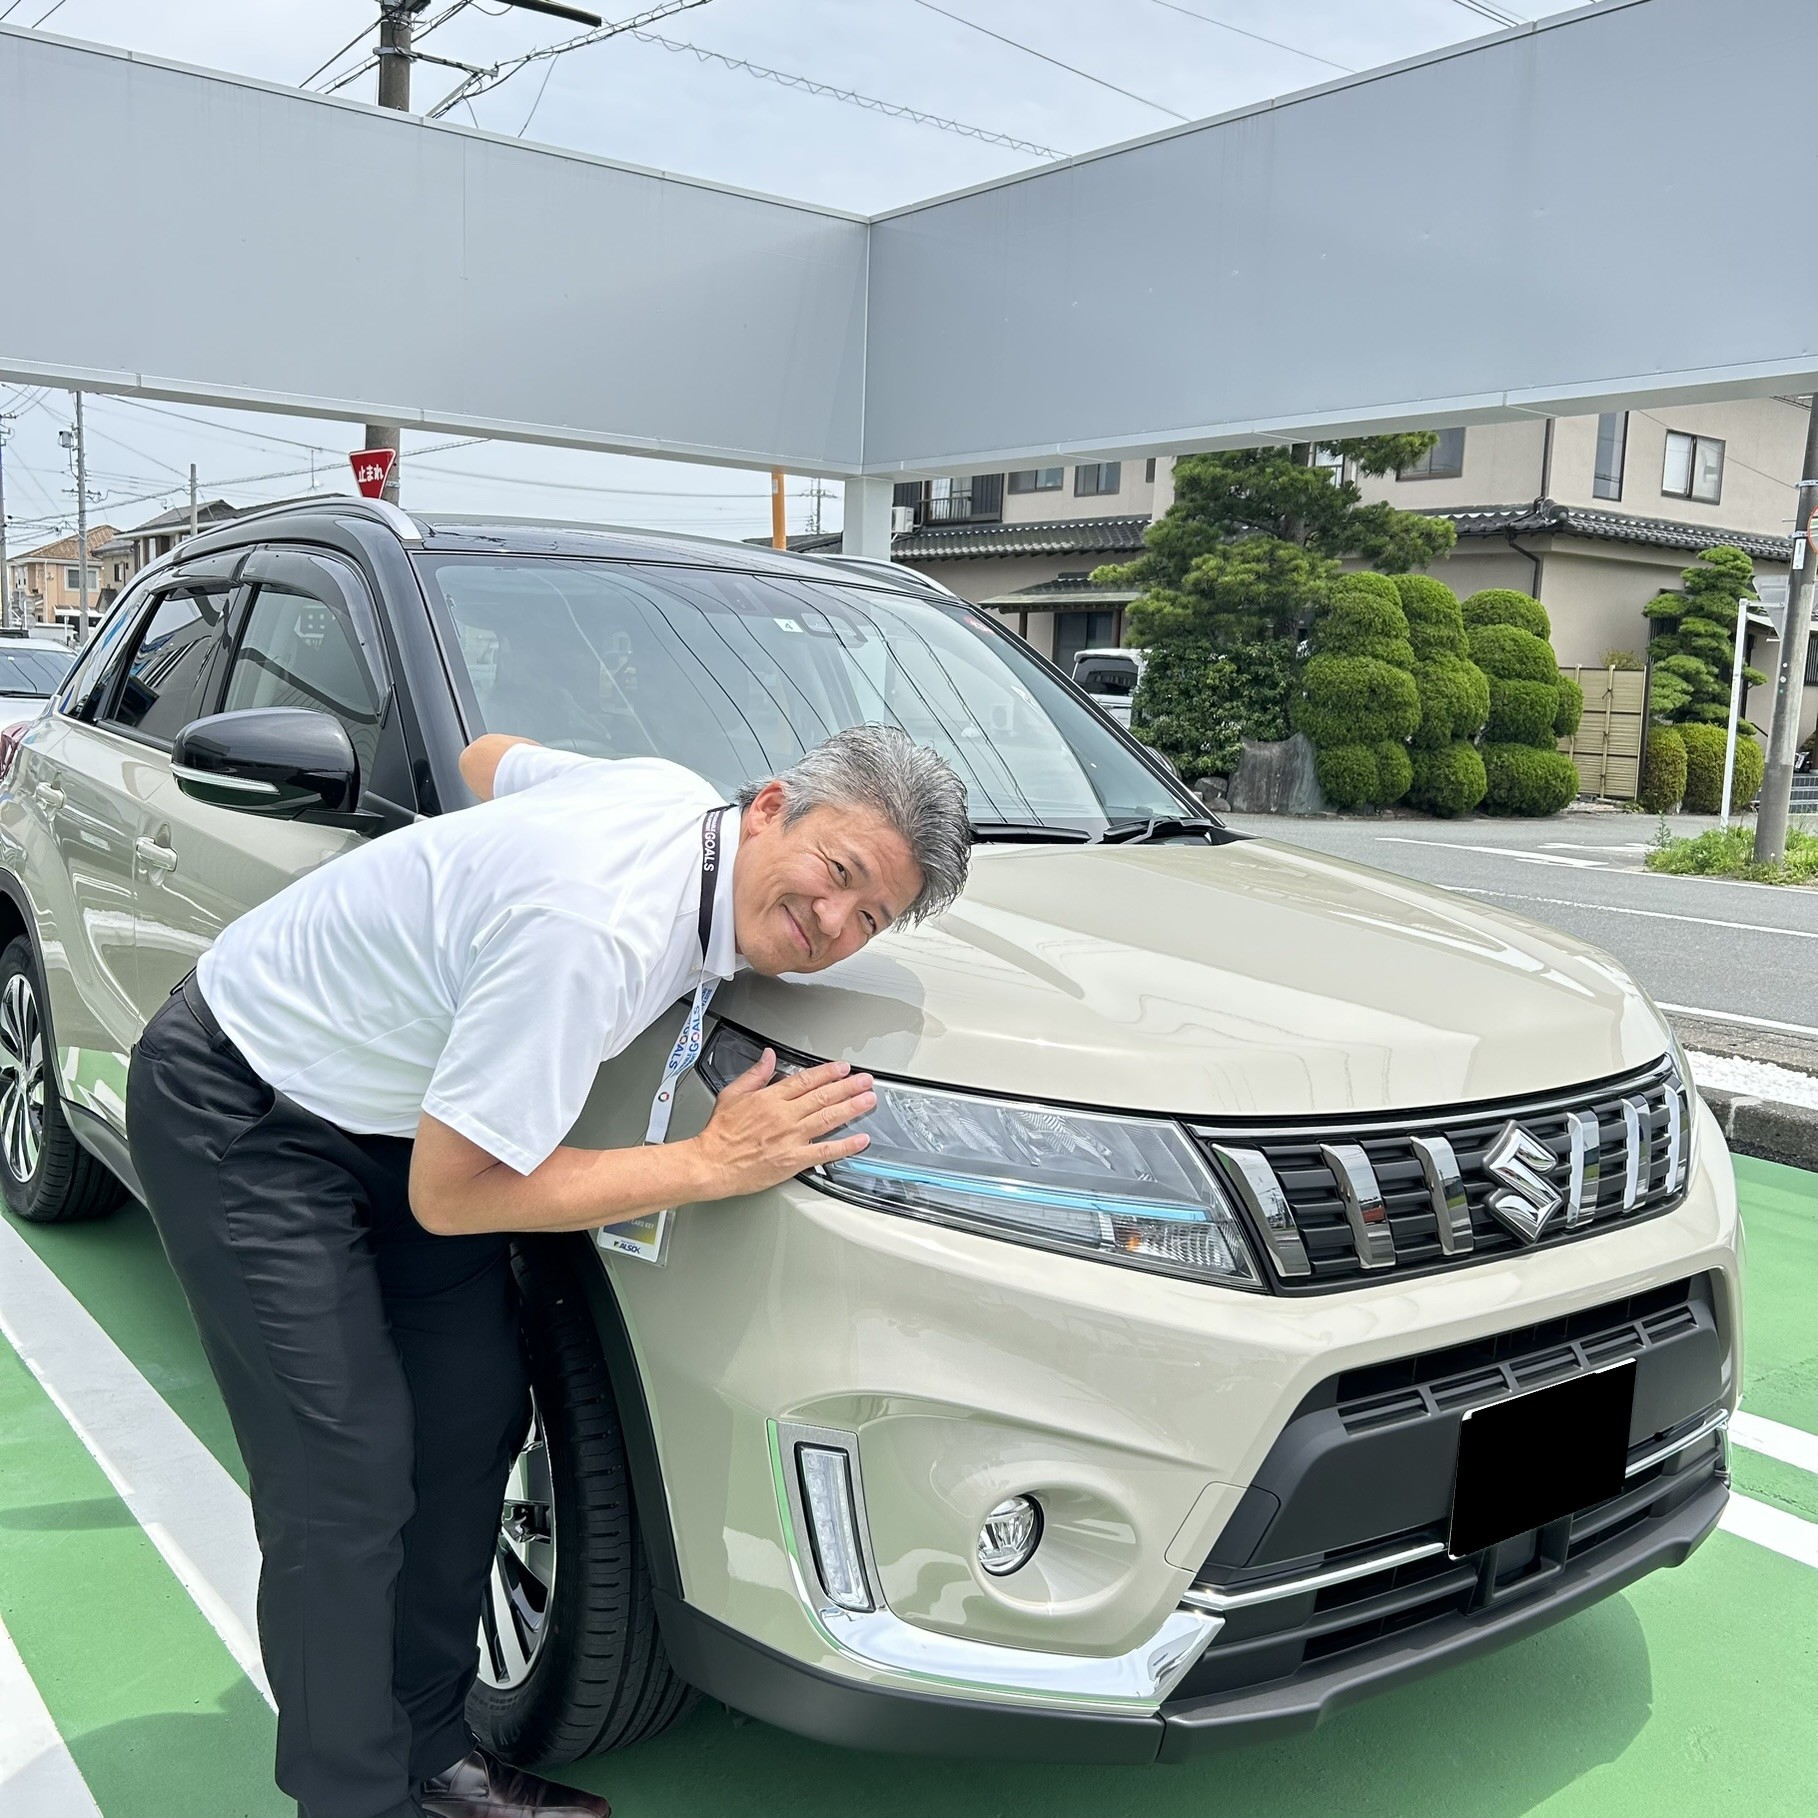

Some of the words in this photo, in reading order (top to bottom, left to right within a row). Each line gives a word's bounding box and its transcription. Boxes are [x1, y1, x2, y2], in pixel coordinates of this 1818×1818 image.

[358, 464, 384, 482] 止まれ
[703, 832, 716, 871] GOALS
[688, 1005, 700, 1052] GOALS
[619, 1243, 641, 1254] ALSOK
